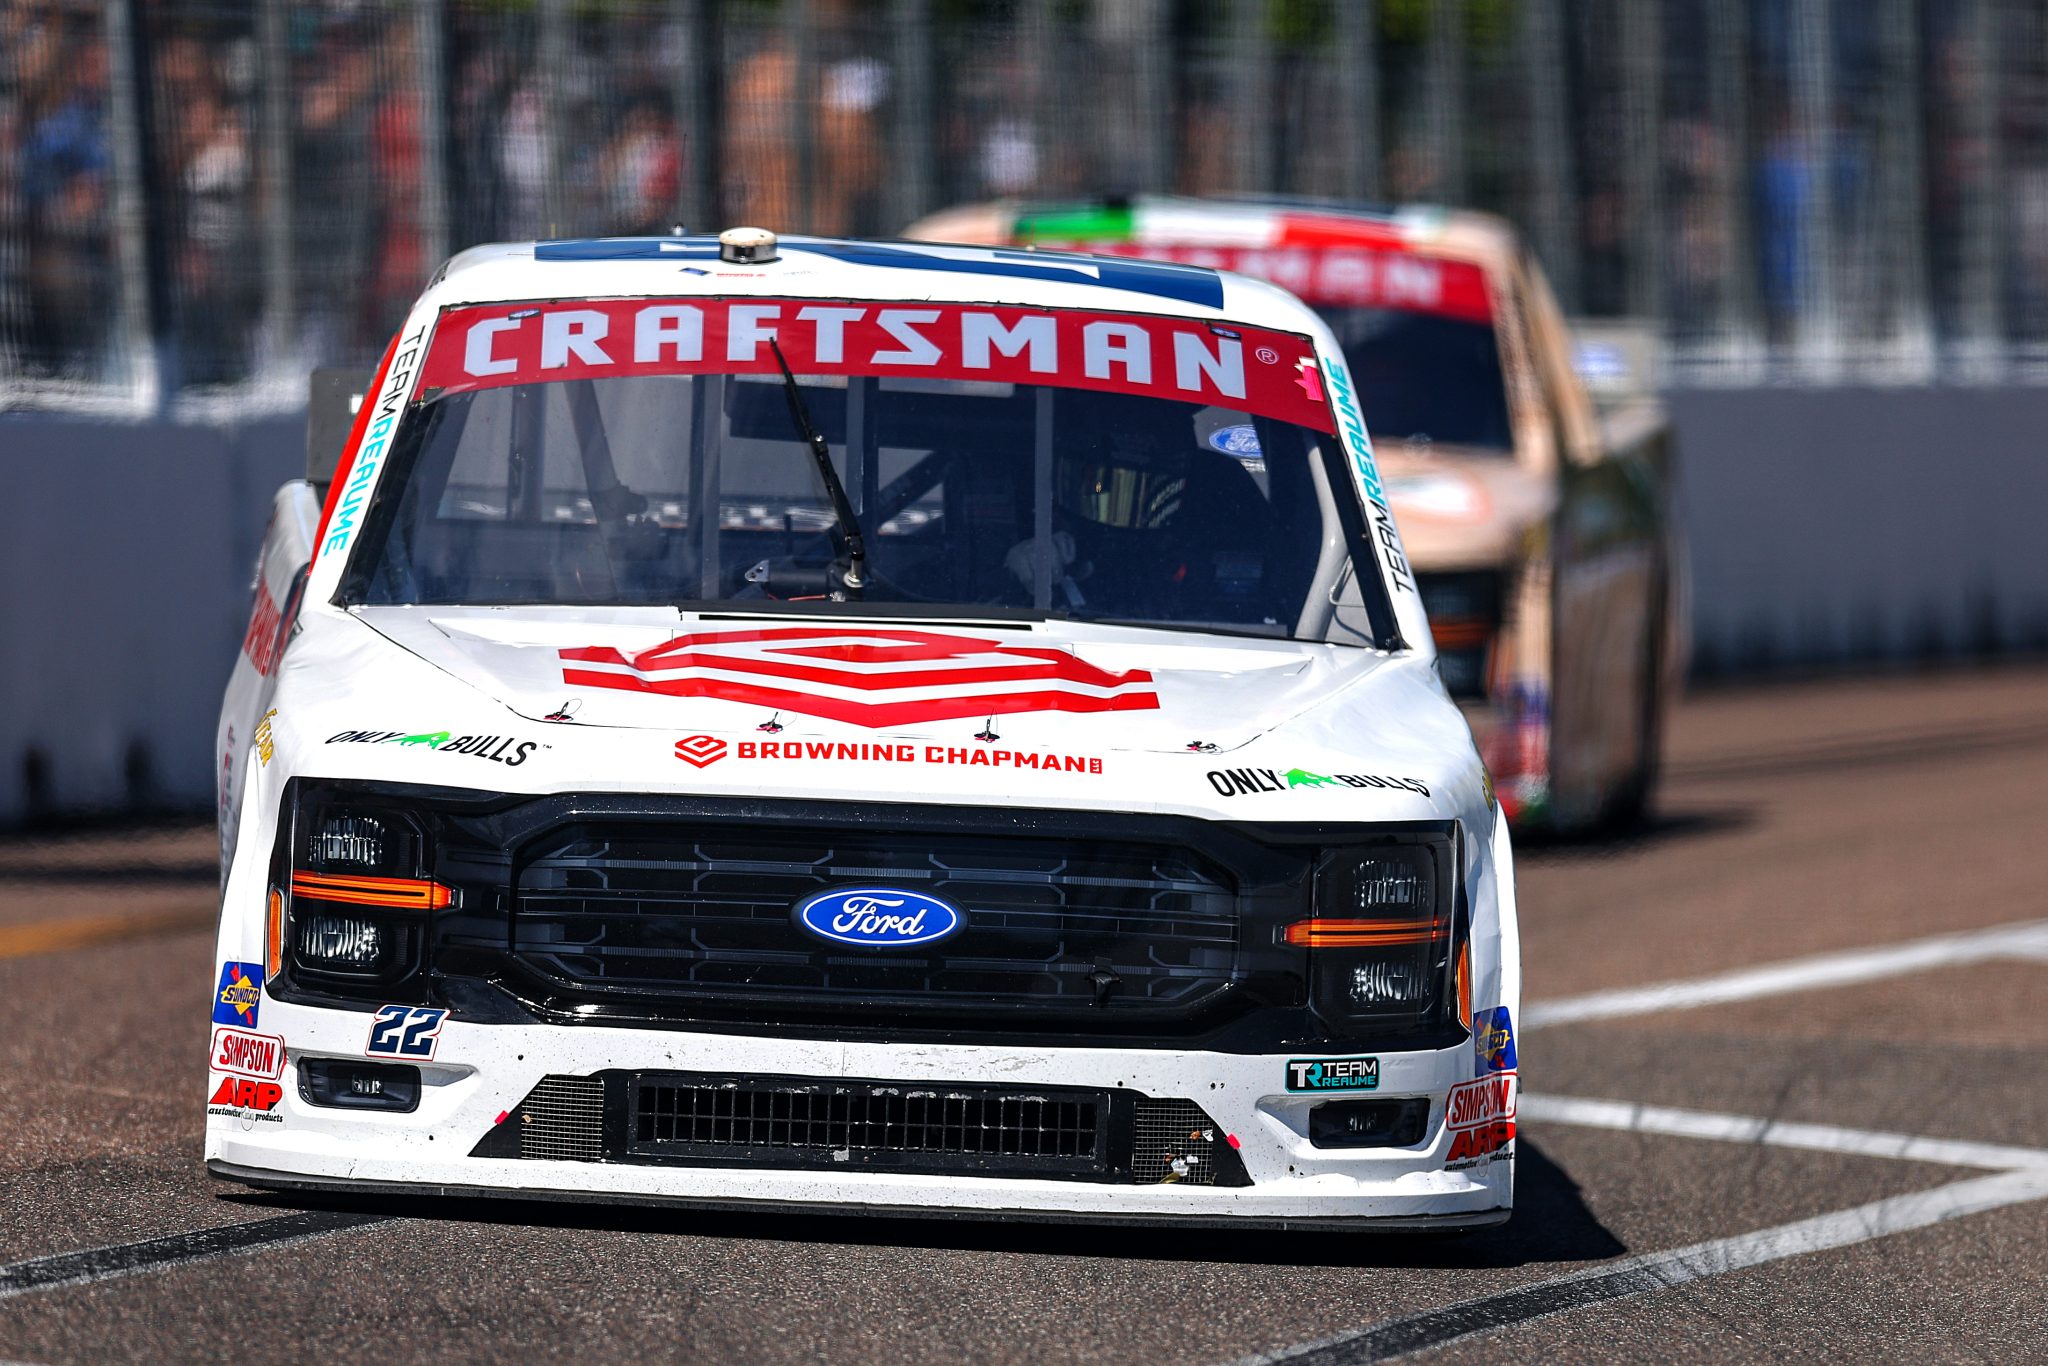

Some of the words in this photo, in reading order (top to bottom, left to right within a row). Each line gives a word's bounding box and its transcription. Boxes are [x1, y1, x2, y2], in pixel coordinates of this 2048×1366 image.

[464, 305, 1246, 399] CRAFTSMAN
[325, 731, 406, 744] ONLY
[438, 735, 537, 766] BULLS
[738, 742, 915, 762] BROWNING
[925, 746, 1085, 773] CHAPMAN
[1206, 768, 1286, 797] ONLY
[1334, 774, 1431, 798] BULLS
[832, 896, 928, 936] Ford
[224, 987, 258, 1005] SUNOCO
[368, 1005, 447, 1056] 22
[219, 1035, 275, 1073] SIMPSON
[1323, 1060, 1377, 1077] TEAM
[209, 1077, 283, 1112] ARP
[1322, 1076, 1377, 1087] REAUME
[255, 1112, 284, 1123] products
[1452, 1079, 1511, 1124] SIMPSON
[1445, 1122, 1516, 1162] ARP
